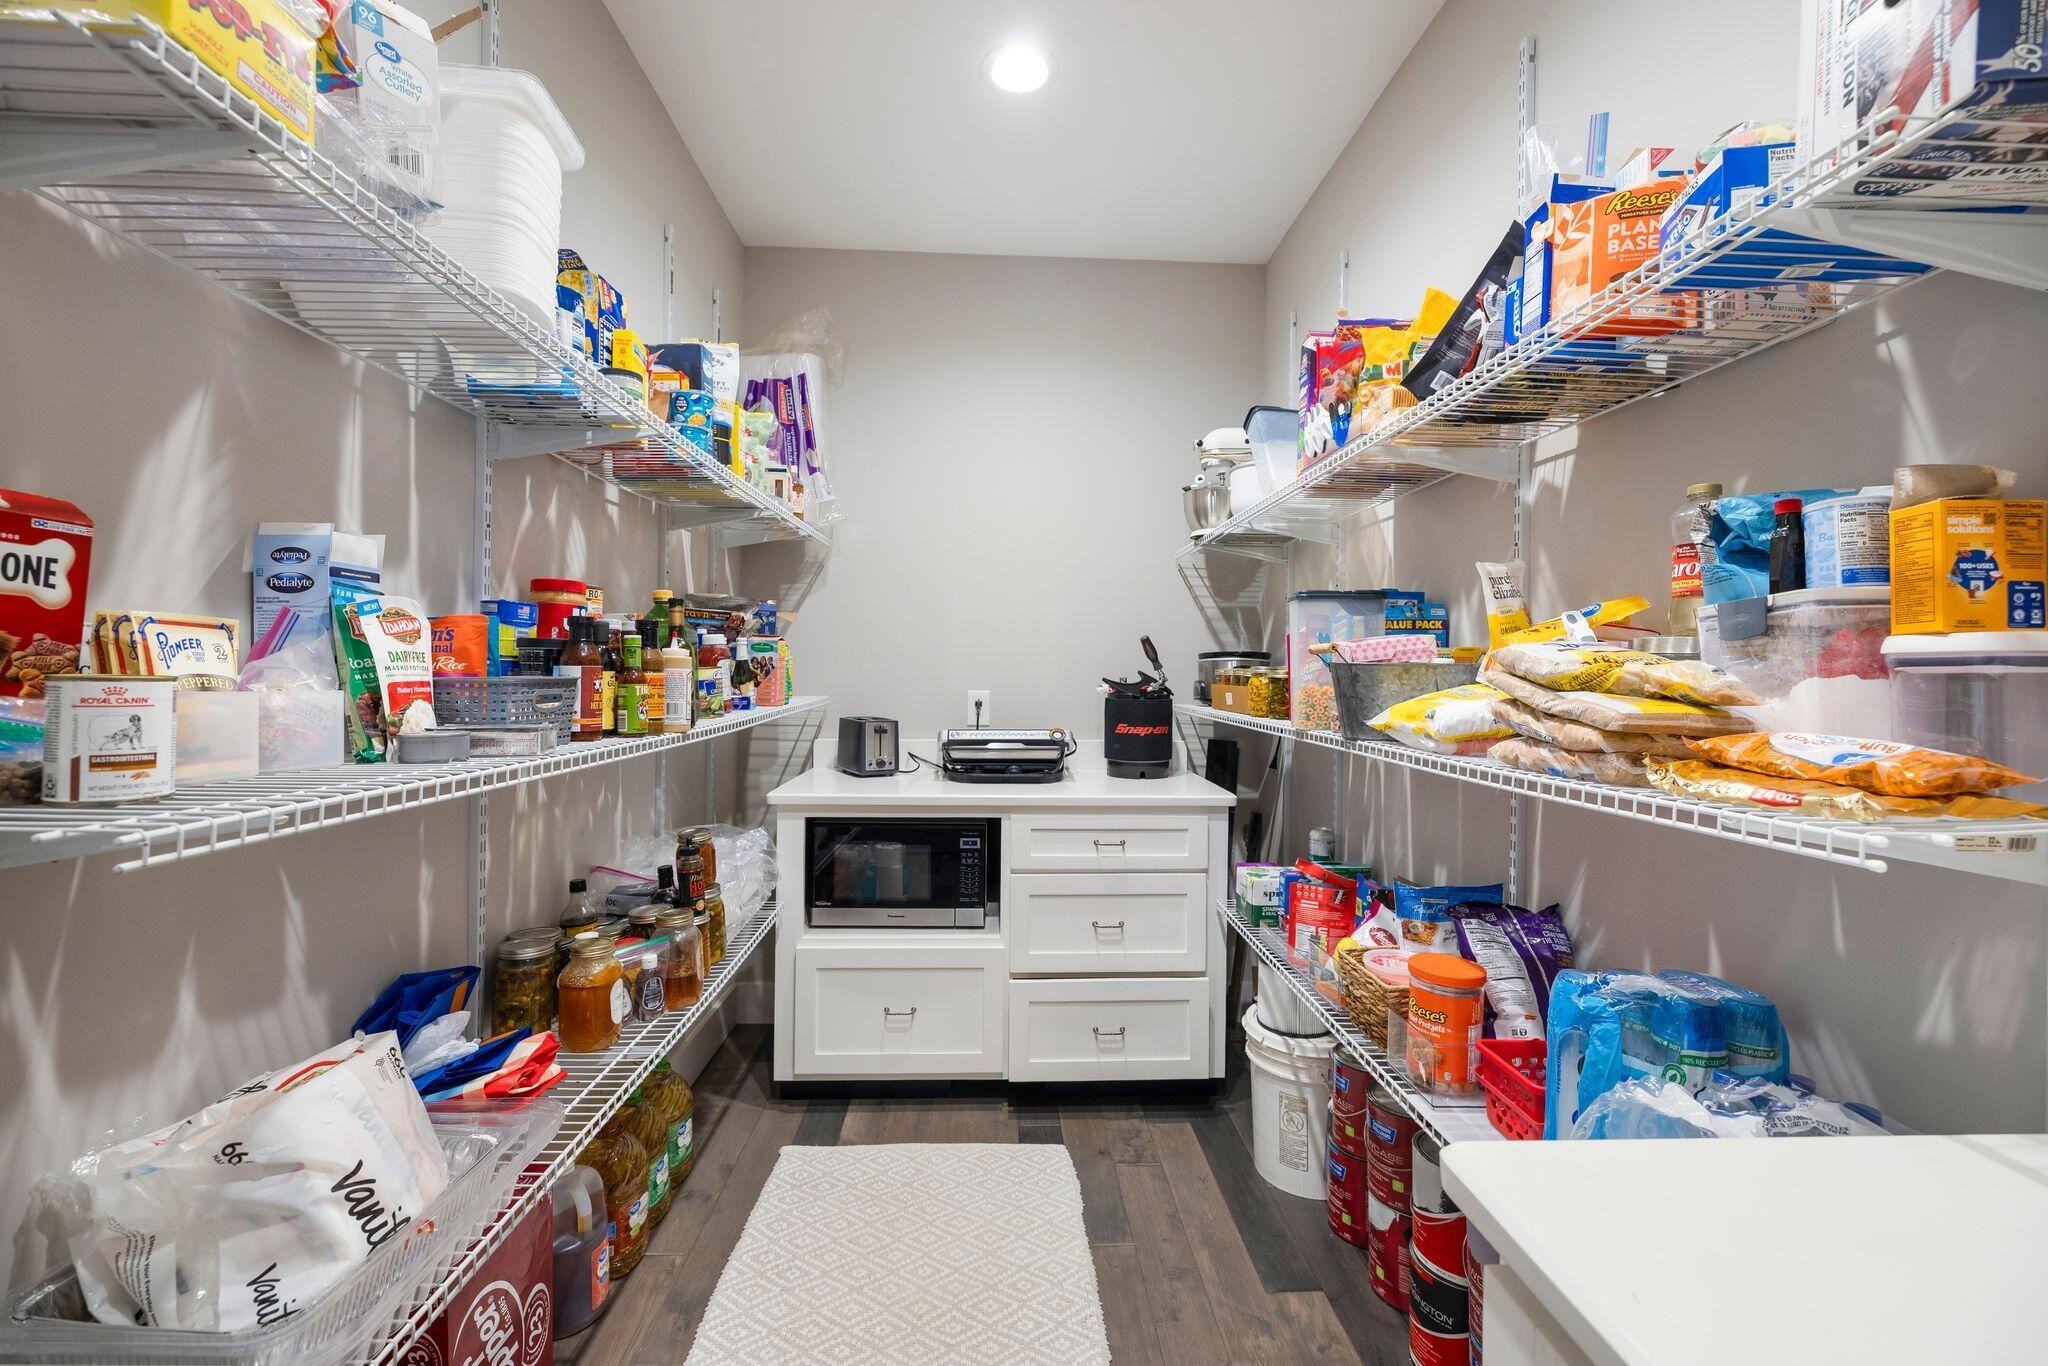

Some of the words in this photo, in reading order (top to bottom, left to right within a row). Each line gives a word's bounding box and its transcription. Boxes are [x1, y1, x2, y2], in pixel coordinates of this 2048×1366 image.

[358, 6, 377, 25] 96
[251, 73, 300, 115] CAUTION
[385, 78, 420, 102] Cutlery
[1605, 189, 1679, 215] Reese's
[1608, 219, 1661, 237] PLAN
[1608, 237, 1659, 255] BASE
[1513, 289, 1521, 336] OREO
[1947, 516, 1982, 525] simple
[1947, 525, 1994, 534] solutions
[272, 551, 308, 561] Pedialyte
[1, 551, 59, 590] ONE
[270, 577, 312, 589] Pedialyte
[1488, 572, 1512, 589] purel
[1493, 585, 1524, 600] elizabe
[363, 602, 380, 612] NEW!
[383, 618, 421, 633] IDAHOAN
[1385, 620, 1413, 630] ALUE
[1415, 619, 1442, 630] PACK
[156, 632, 205, 670] PIONEER
[214, 645, 228, 661] 2
[176, 676, 234, 691] PEPPERED
[80, 697, 112, 705] ROYAL
[1115, 723, 1169, 736] Snap-on
[1409, 997, 1448, 1023] Reese's
